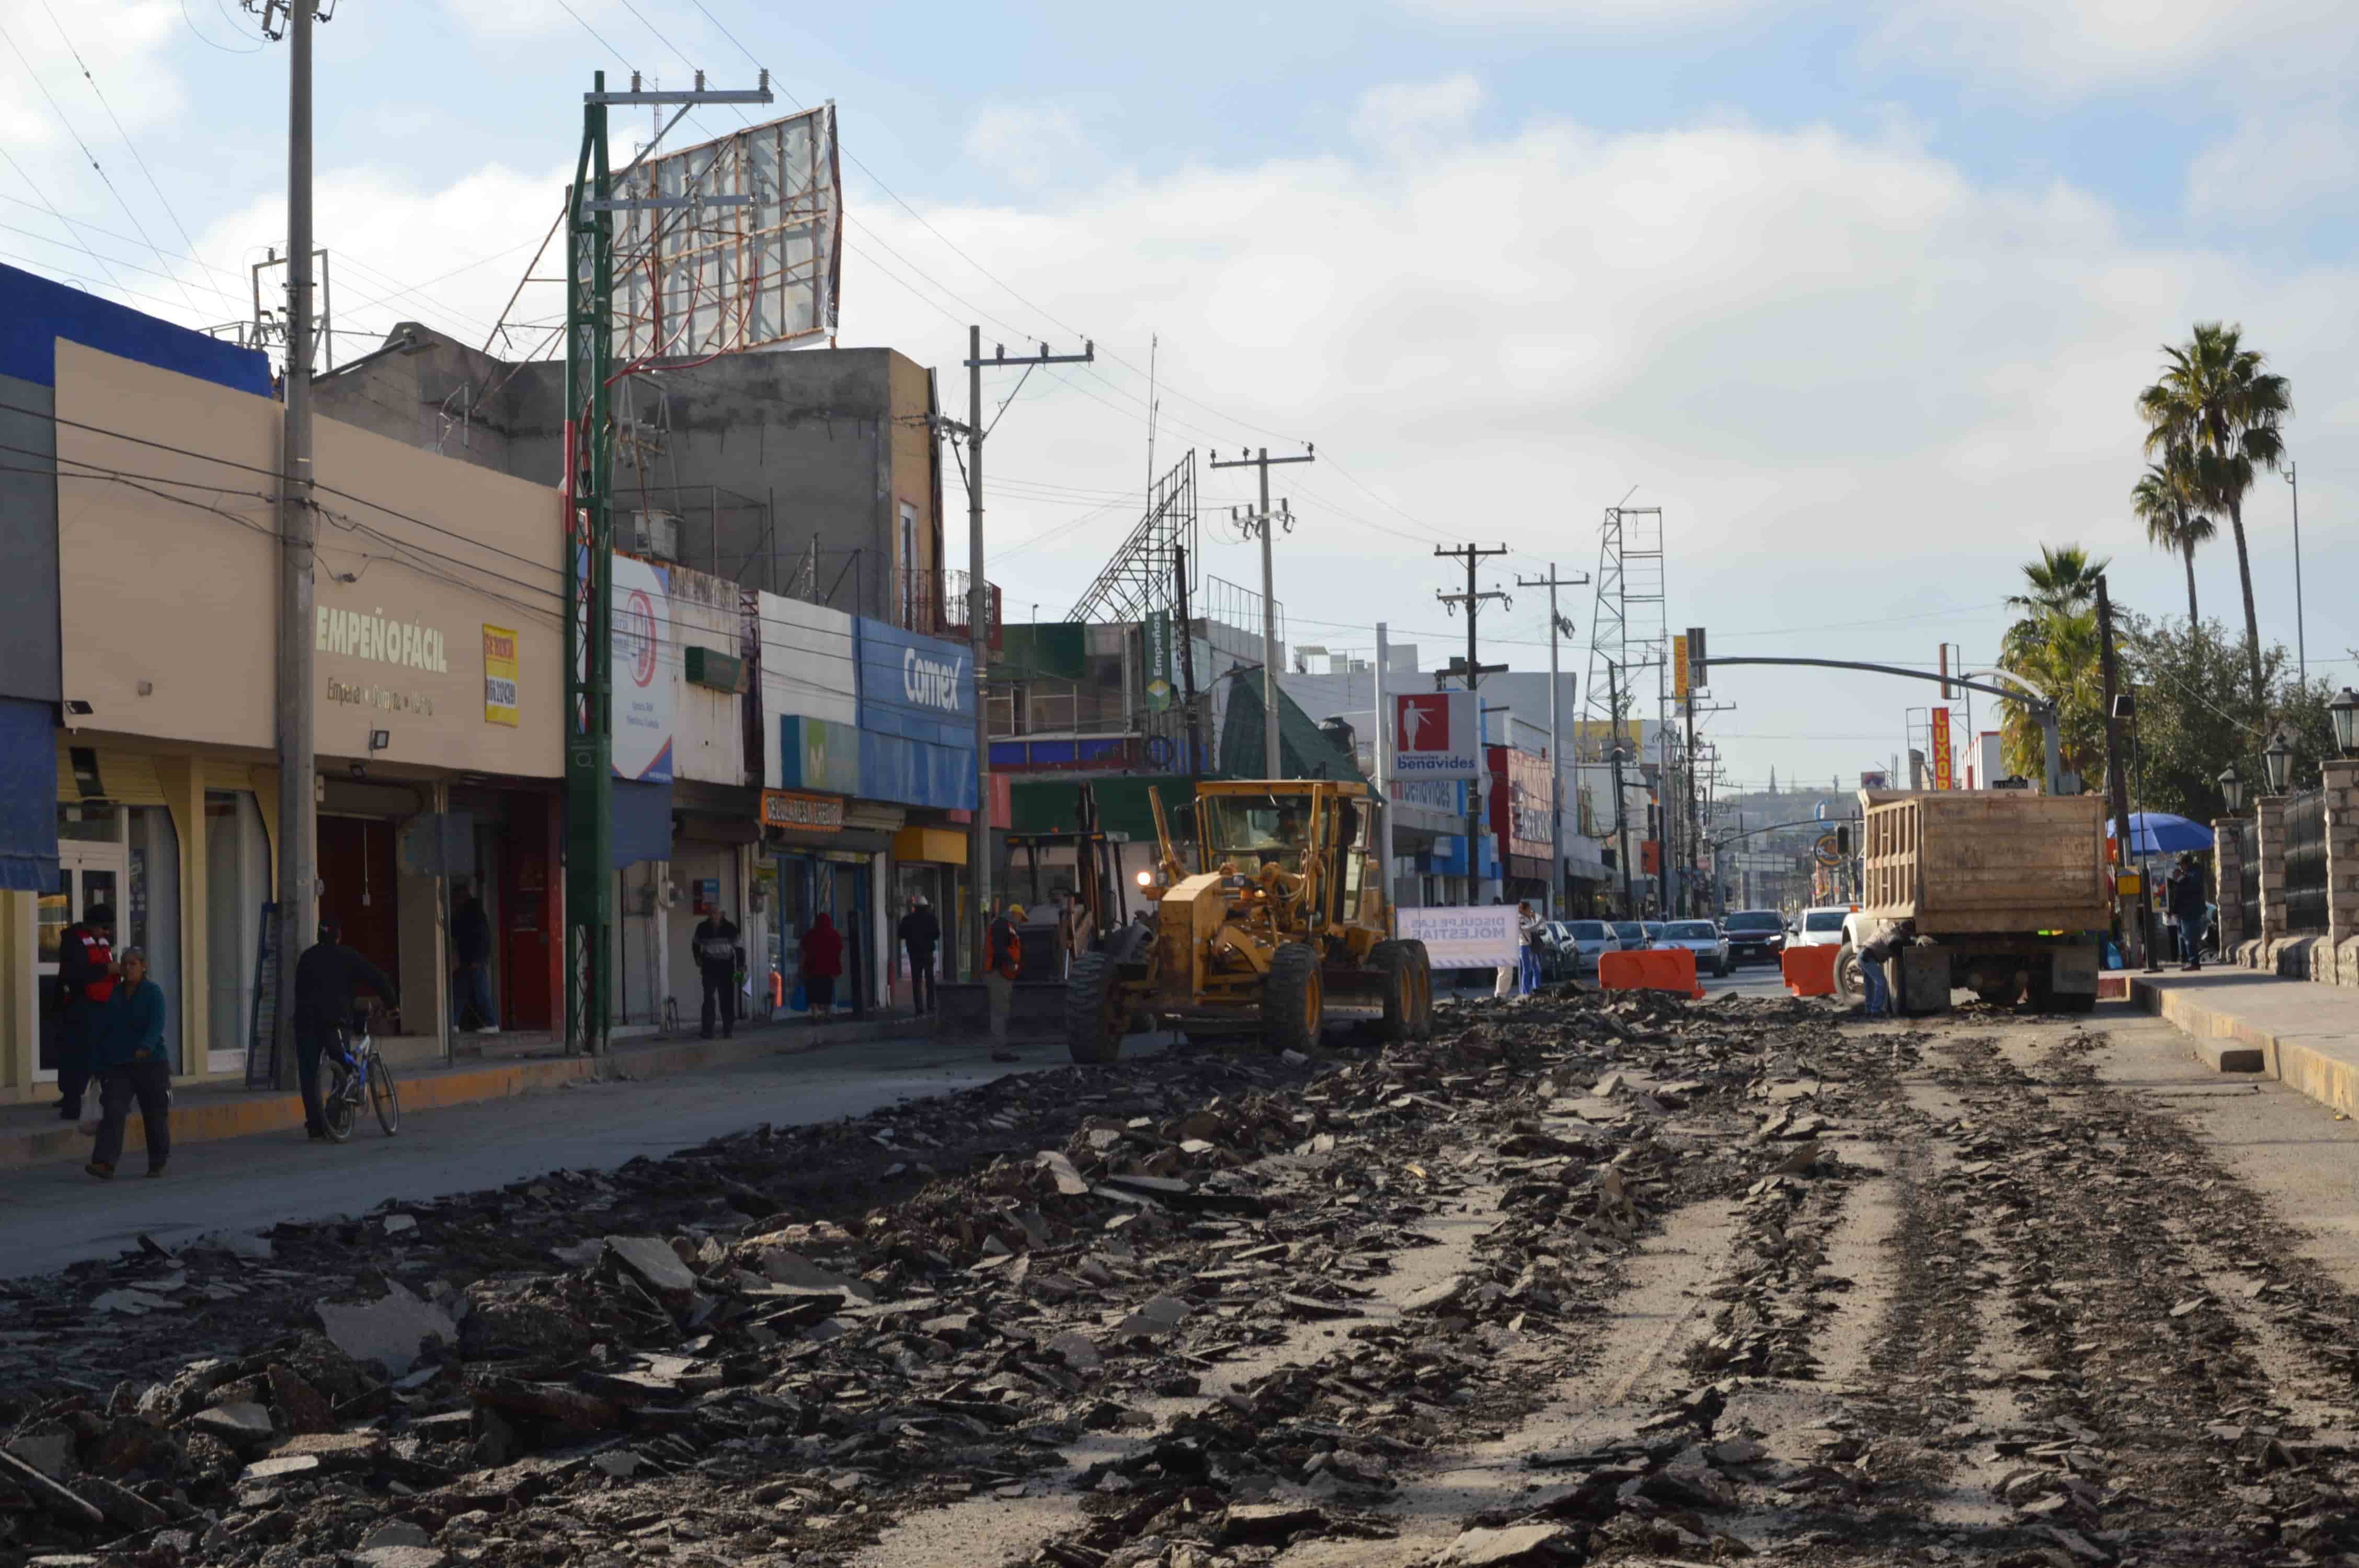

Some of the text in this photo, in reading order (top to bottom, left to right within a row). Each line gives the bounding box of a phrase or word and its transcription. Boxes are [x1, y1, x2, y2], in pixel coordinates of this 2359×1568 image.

[1152, 614, 1163, 676] Empeños
[904, 648, 963, 711] Comex
[1398, 756, 1475, 770] benavides
